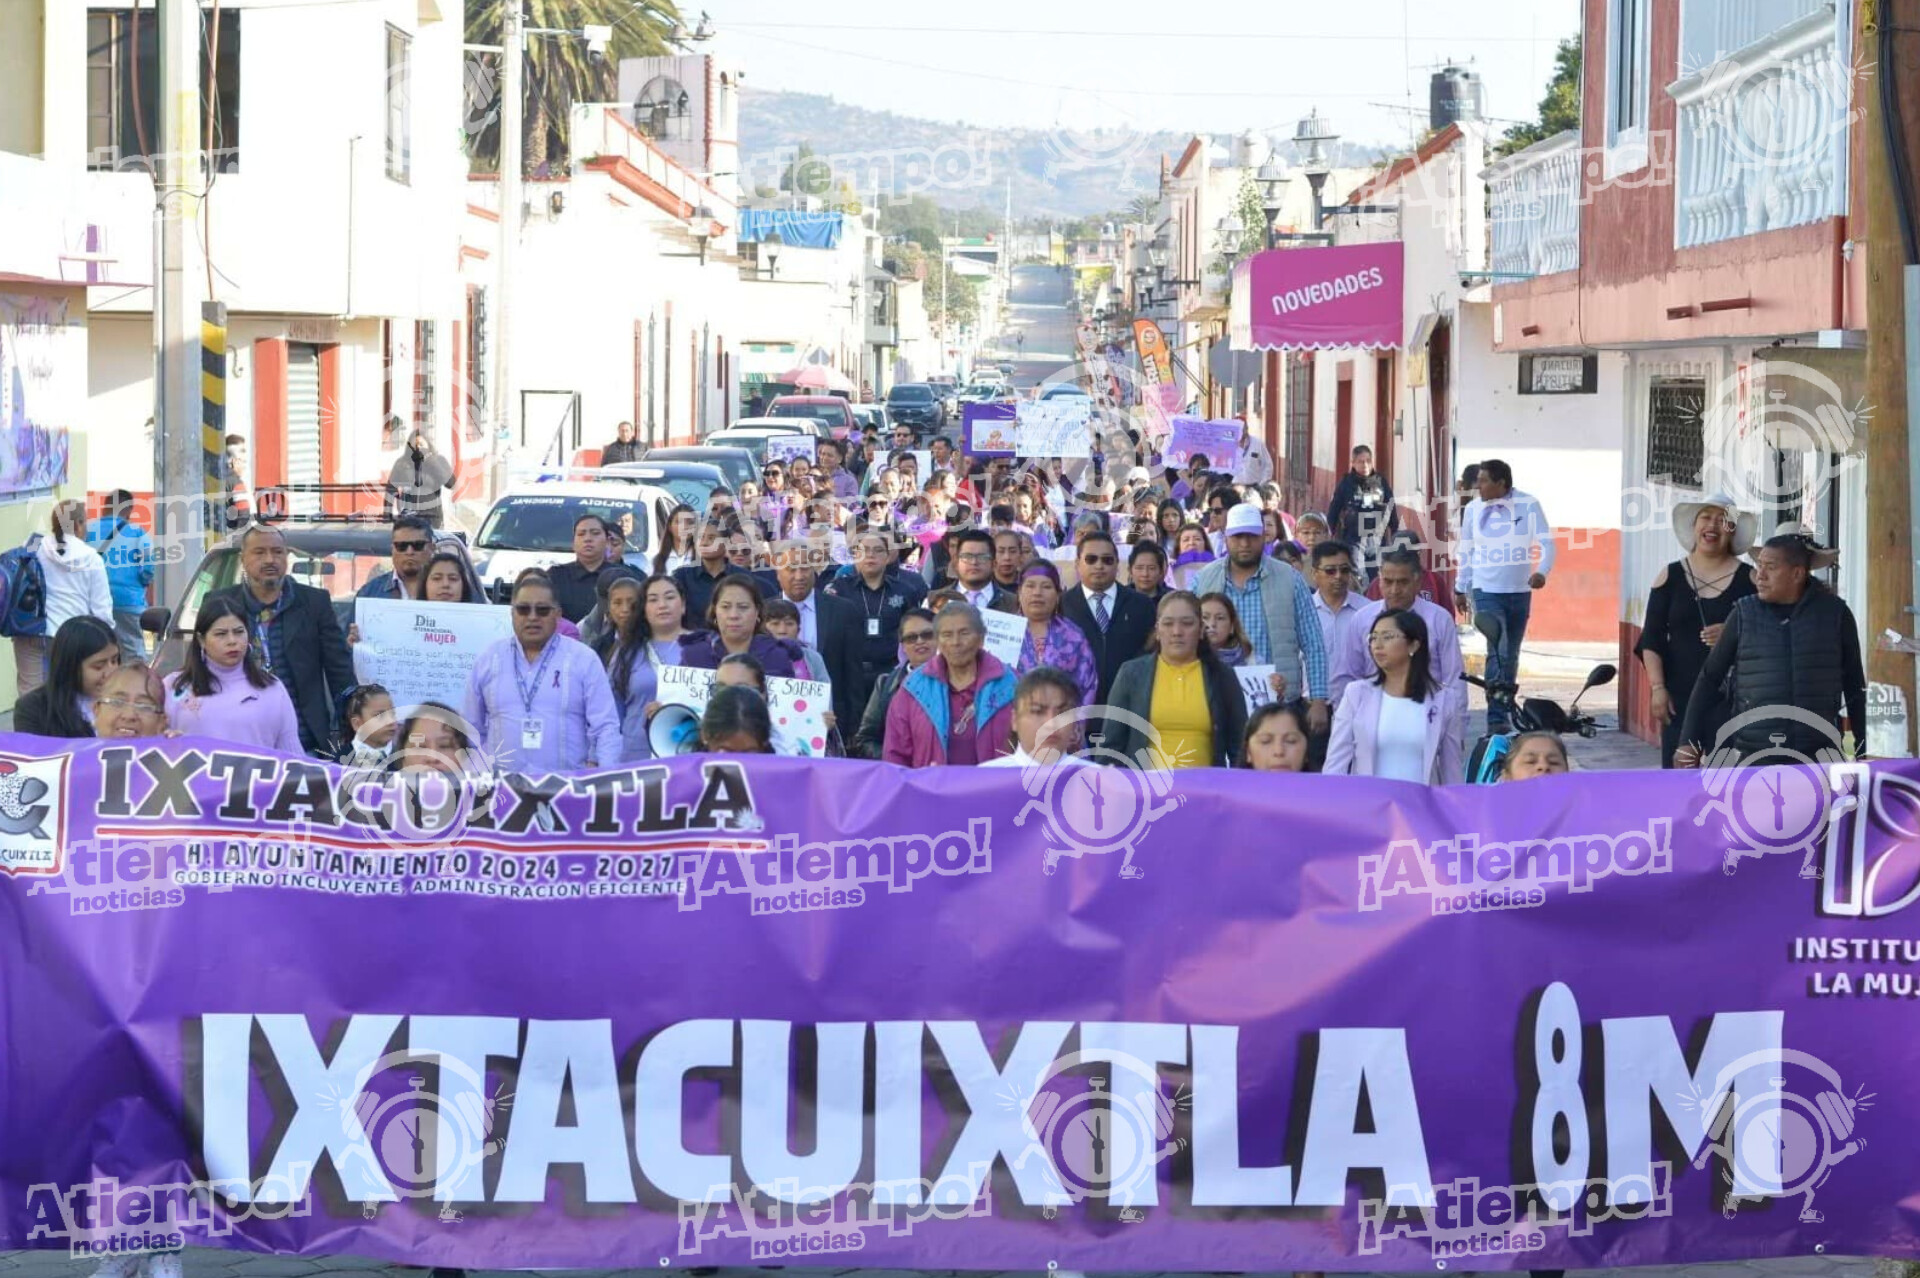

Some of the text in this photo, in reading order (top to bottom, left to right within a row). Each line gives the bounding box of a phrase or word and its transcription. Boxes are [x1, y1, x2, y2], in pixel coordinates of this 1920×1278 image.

[1272, 267, 1384, 315] NOVEDADES
[424, 633, 456, 645] MUJER
[97, 748, 764, 833] IXTACUIXTLA
[225, 845, 467, 876] AYUNTAMIENTO
[482, 856, 557, 879] 2024
[599, 857, 673, 877] 2027
[175, 871, 275, 885] GOBIERNO
[589, 880, 686, 896] EFICIENTE
[1814, 972, 1853, 994] LA
[201, 981, 1785, 1213] IXTACUIXTLA 8M
